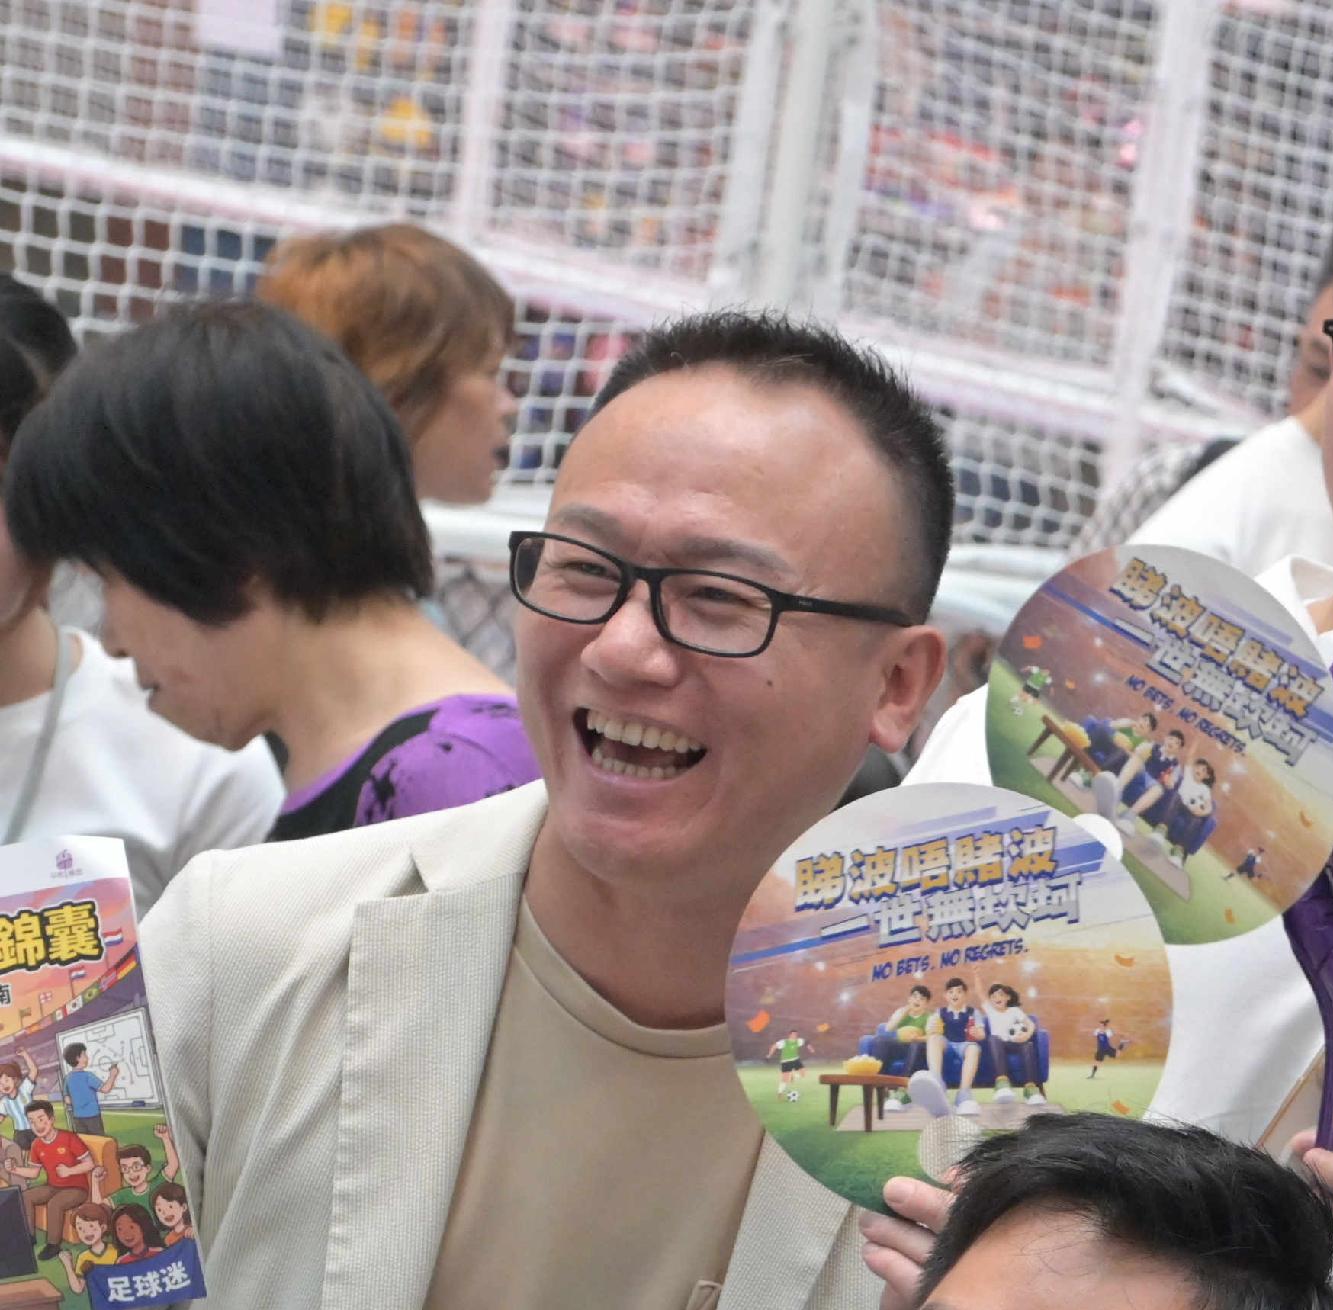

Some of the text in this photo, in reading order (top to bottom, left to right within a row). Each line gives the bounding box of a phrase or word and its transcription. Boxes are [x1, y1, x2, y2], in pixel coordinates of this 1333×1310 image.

[1109, 557, 1325, 719] 睇波唔賭波
[794, 824, 1057, 912] 睇波唔賭波
[871, 963, 892, 982] NO
[939, 951, 960, 969] NO
[964, 938, 1030, 963] REGRETS.
[107, 1260, 191, 1302] 足球迷
